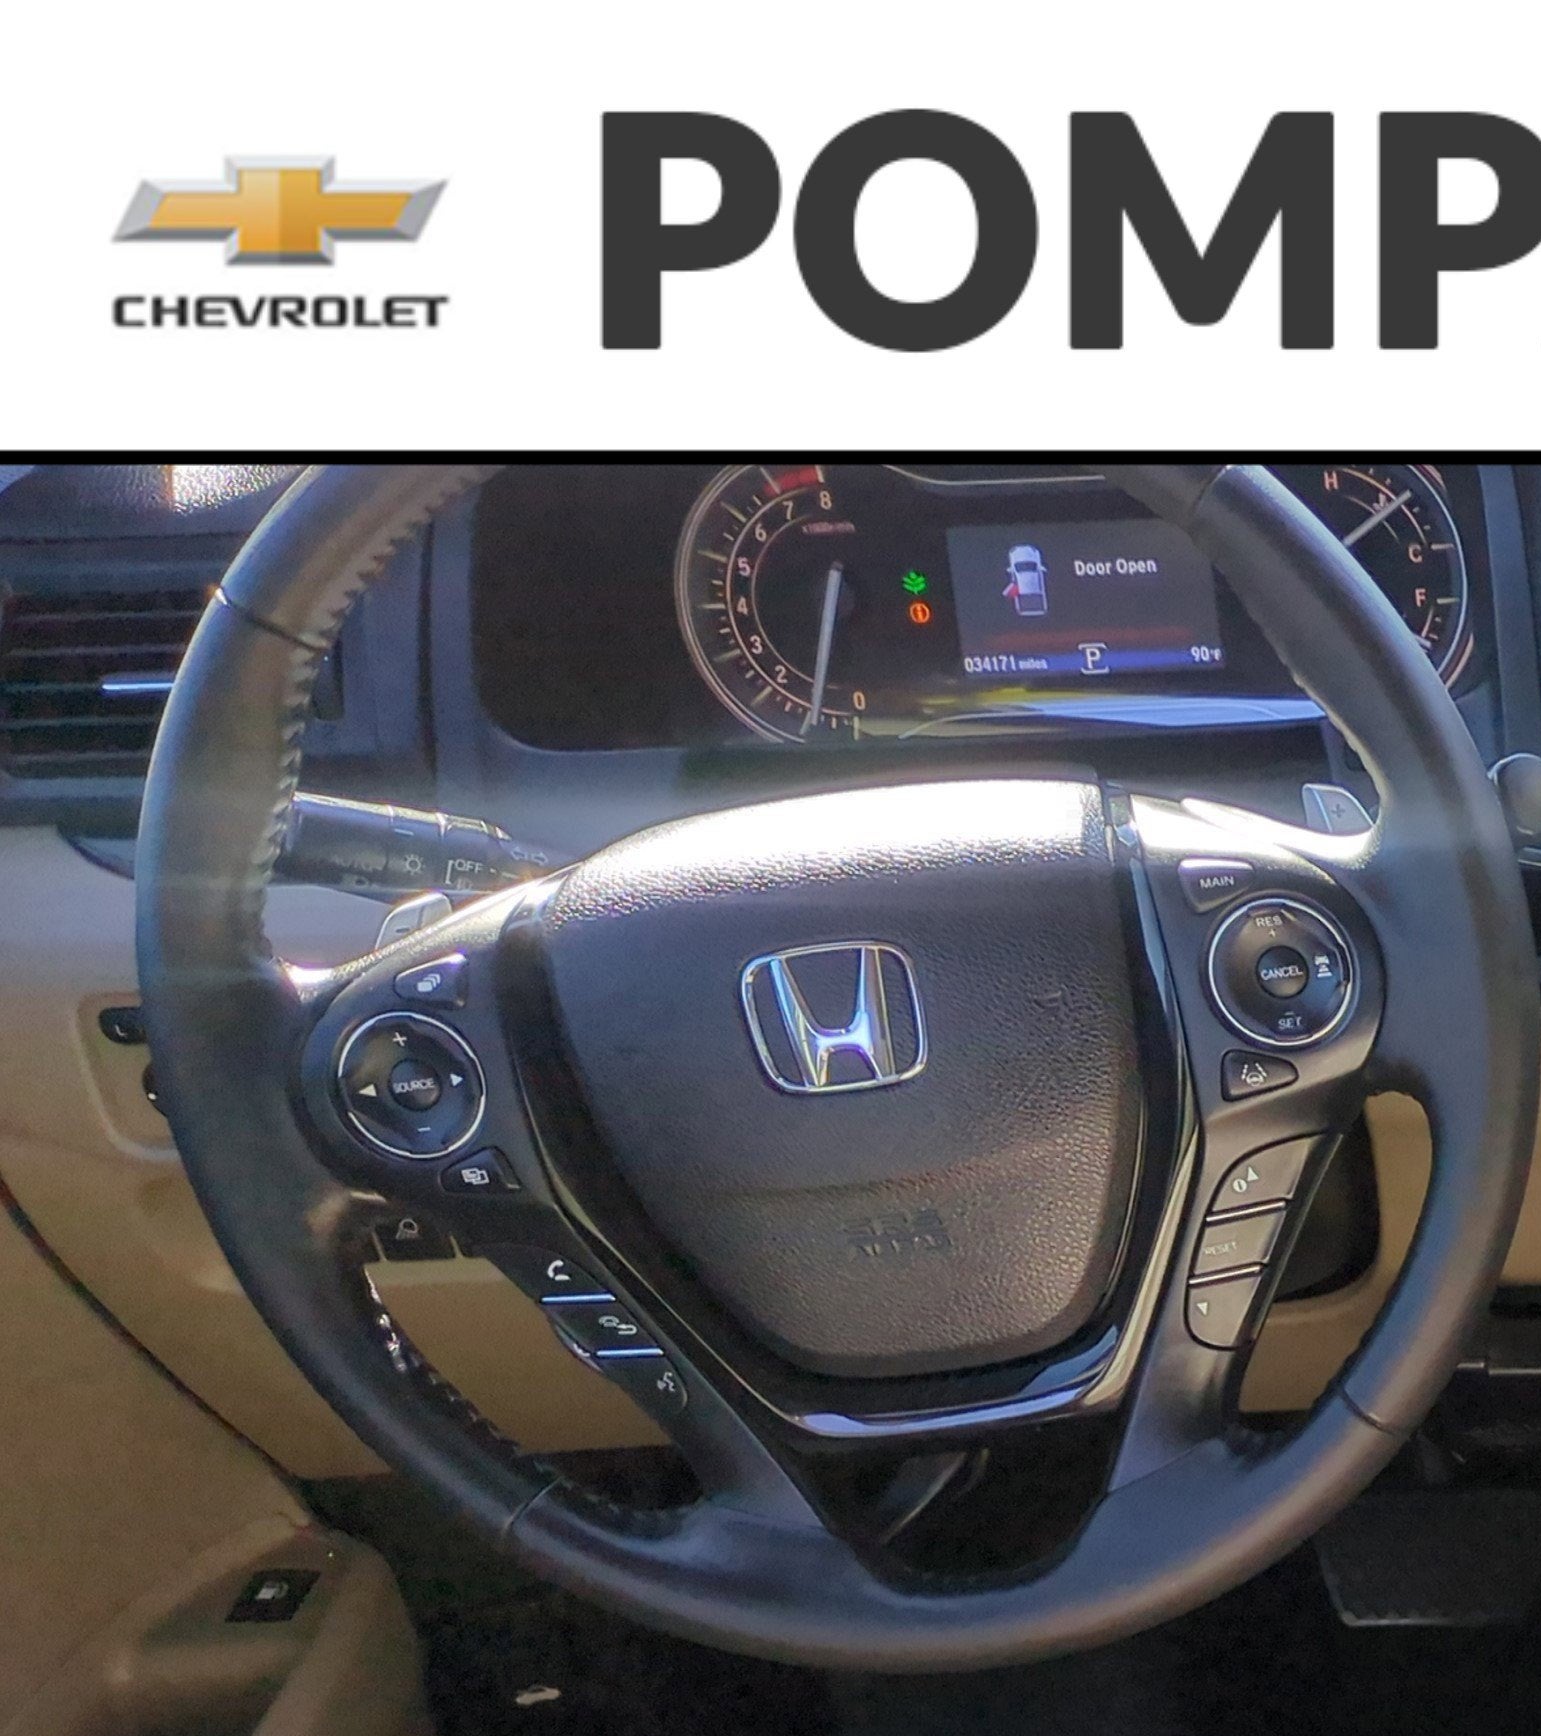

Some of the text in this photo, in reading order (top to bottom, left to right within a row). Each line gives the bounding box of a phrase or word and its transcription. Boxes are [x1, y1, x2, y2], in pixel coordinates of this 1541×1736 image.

[1323, 471, 1339, 491] H
[819, 490, 833, 510] 8
[783, 501, 794, 521] 7
[755, 523, 767, 542] 6
[737, 557, 751, 577] 5
[1074, 558, 1158, 577] Door Open
[736, 596, 748, 616] 4
[1415, 588, 1426, 607] F
[751, 635, 763, 654] 3
[964, 656, 1017, 673] 034171
[1086, 649, 1101, 669] P
[775, 665, 788, 684] 2
[853, 691, 866, 710] 0
[454, 858, 483, 873] OFF
[1200, 876, 1235, 889] MAIN
[1256, 915, 1283, 928] RES
[1260, 965, 1303, 981] CANCEL
[1278, 1016, 1302, 1030] SET
[1204, 1241, 1237, 1255] RESET
